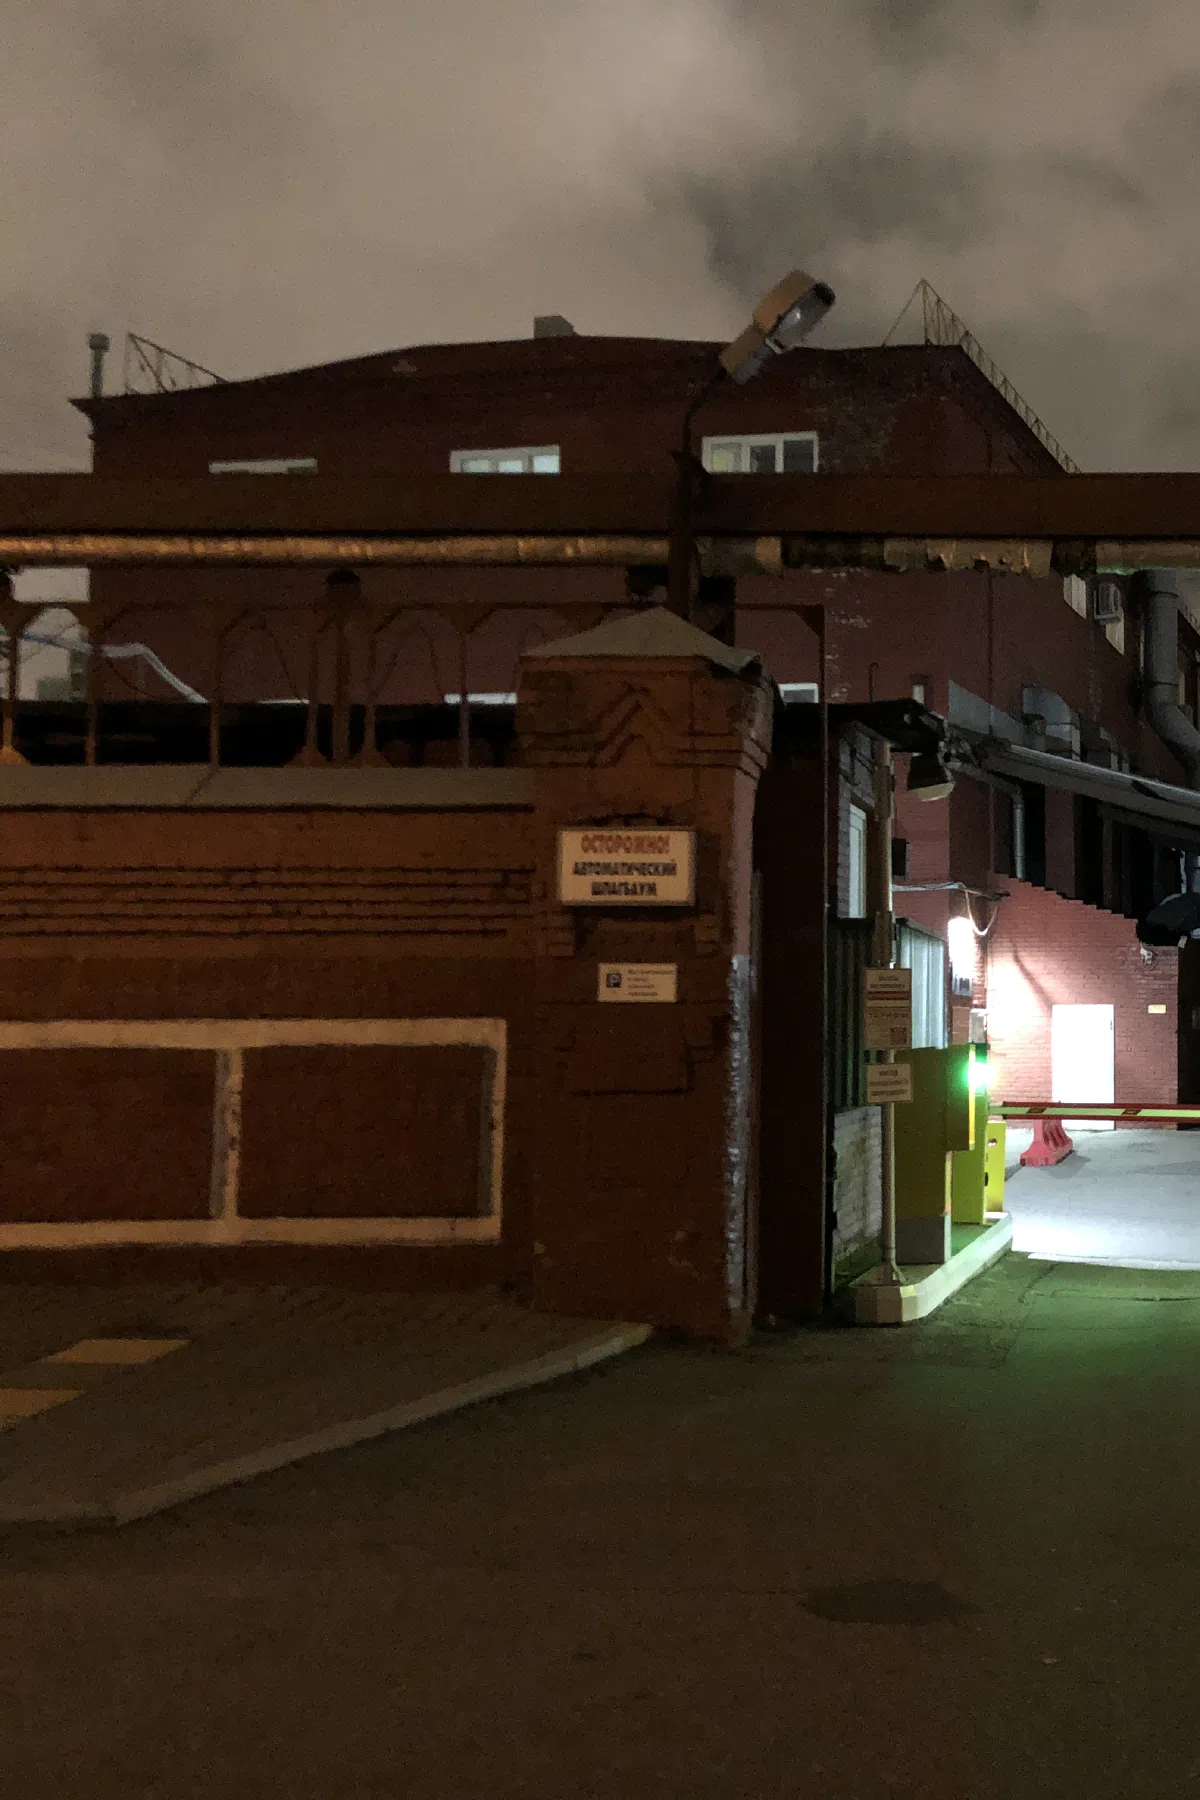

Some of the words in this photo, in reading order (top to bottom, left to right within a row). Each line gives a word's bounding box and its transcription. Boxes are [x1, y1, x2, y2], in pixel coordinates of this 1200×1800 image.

[581, 834, 670, 854] ОСТОРОЖНО!
[573, 859, 677, 876] АВТОМАТИЧЕСКИЙ
[591, 881, 657, 896] ШЛАГБАУМ
